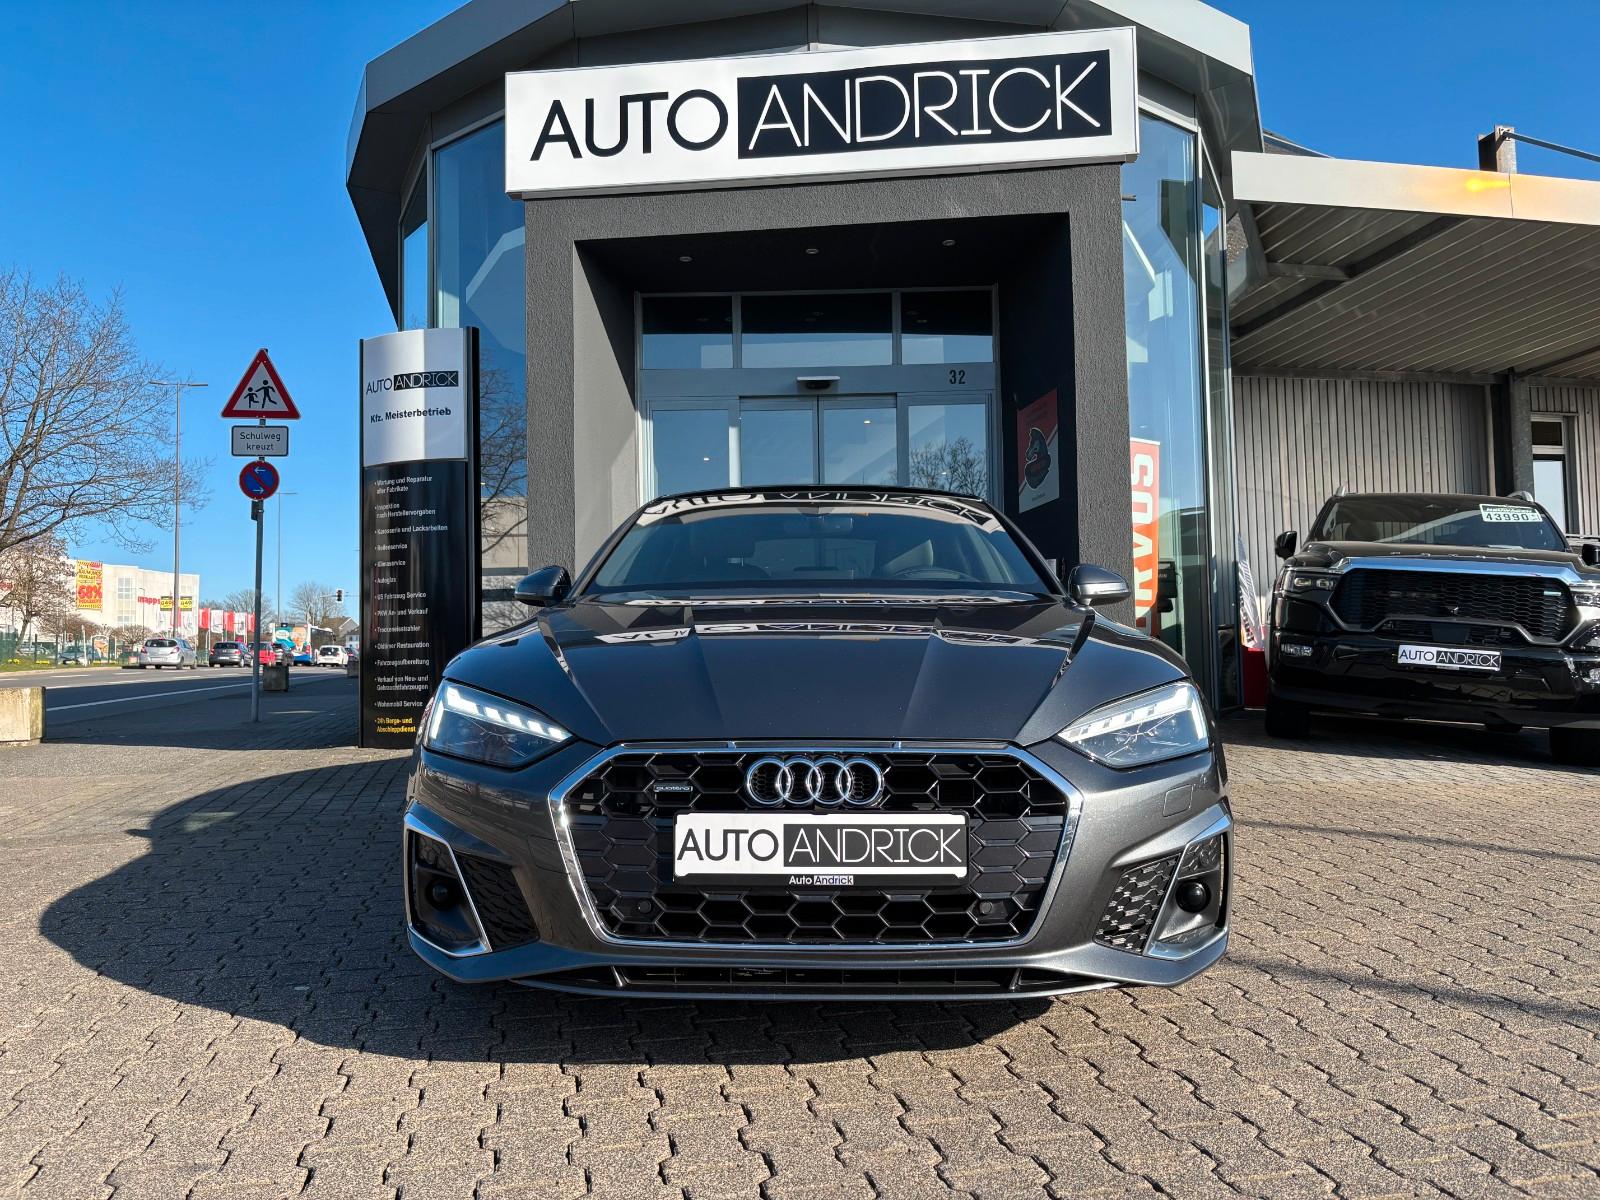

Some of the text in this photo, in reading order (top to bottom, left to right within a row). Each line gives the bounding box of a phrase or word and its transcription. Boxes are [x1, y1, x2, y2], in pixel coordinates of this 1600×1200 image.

[529, 61, 1101, 162] AUTO ANDRICK
[366, 371, 457, 395] AUTO ANDRICK
[949, 369, 966, 385] 32
[370, 407, 452, 423] Kfz. Meisterbetrieb
[239, 432, 281, 442] Schulweg
[246, 443, 274, 451] kreuzt
[1399, 649, 1499, 667] AUTO ANDRICK
[676, 827, 962, 863] AUTO ANDRICK
[788, 874, 853, 885] Auto Andrick
